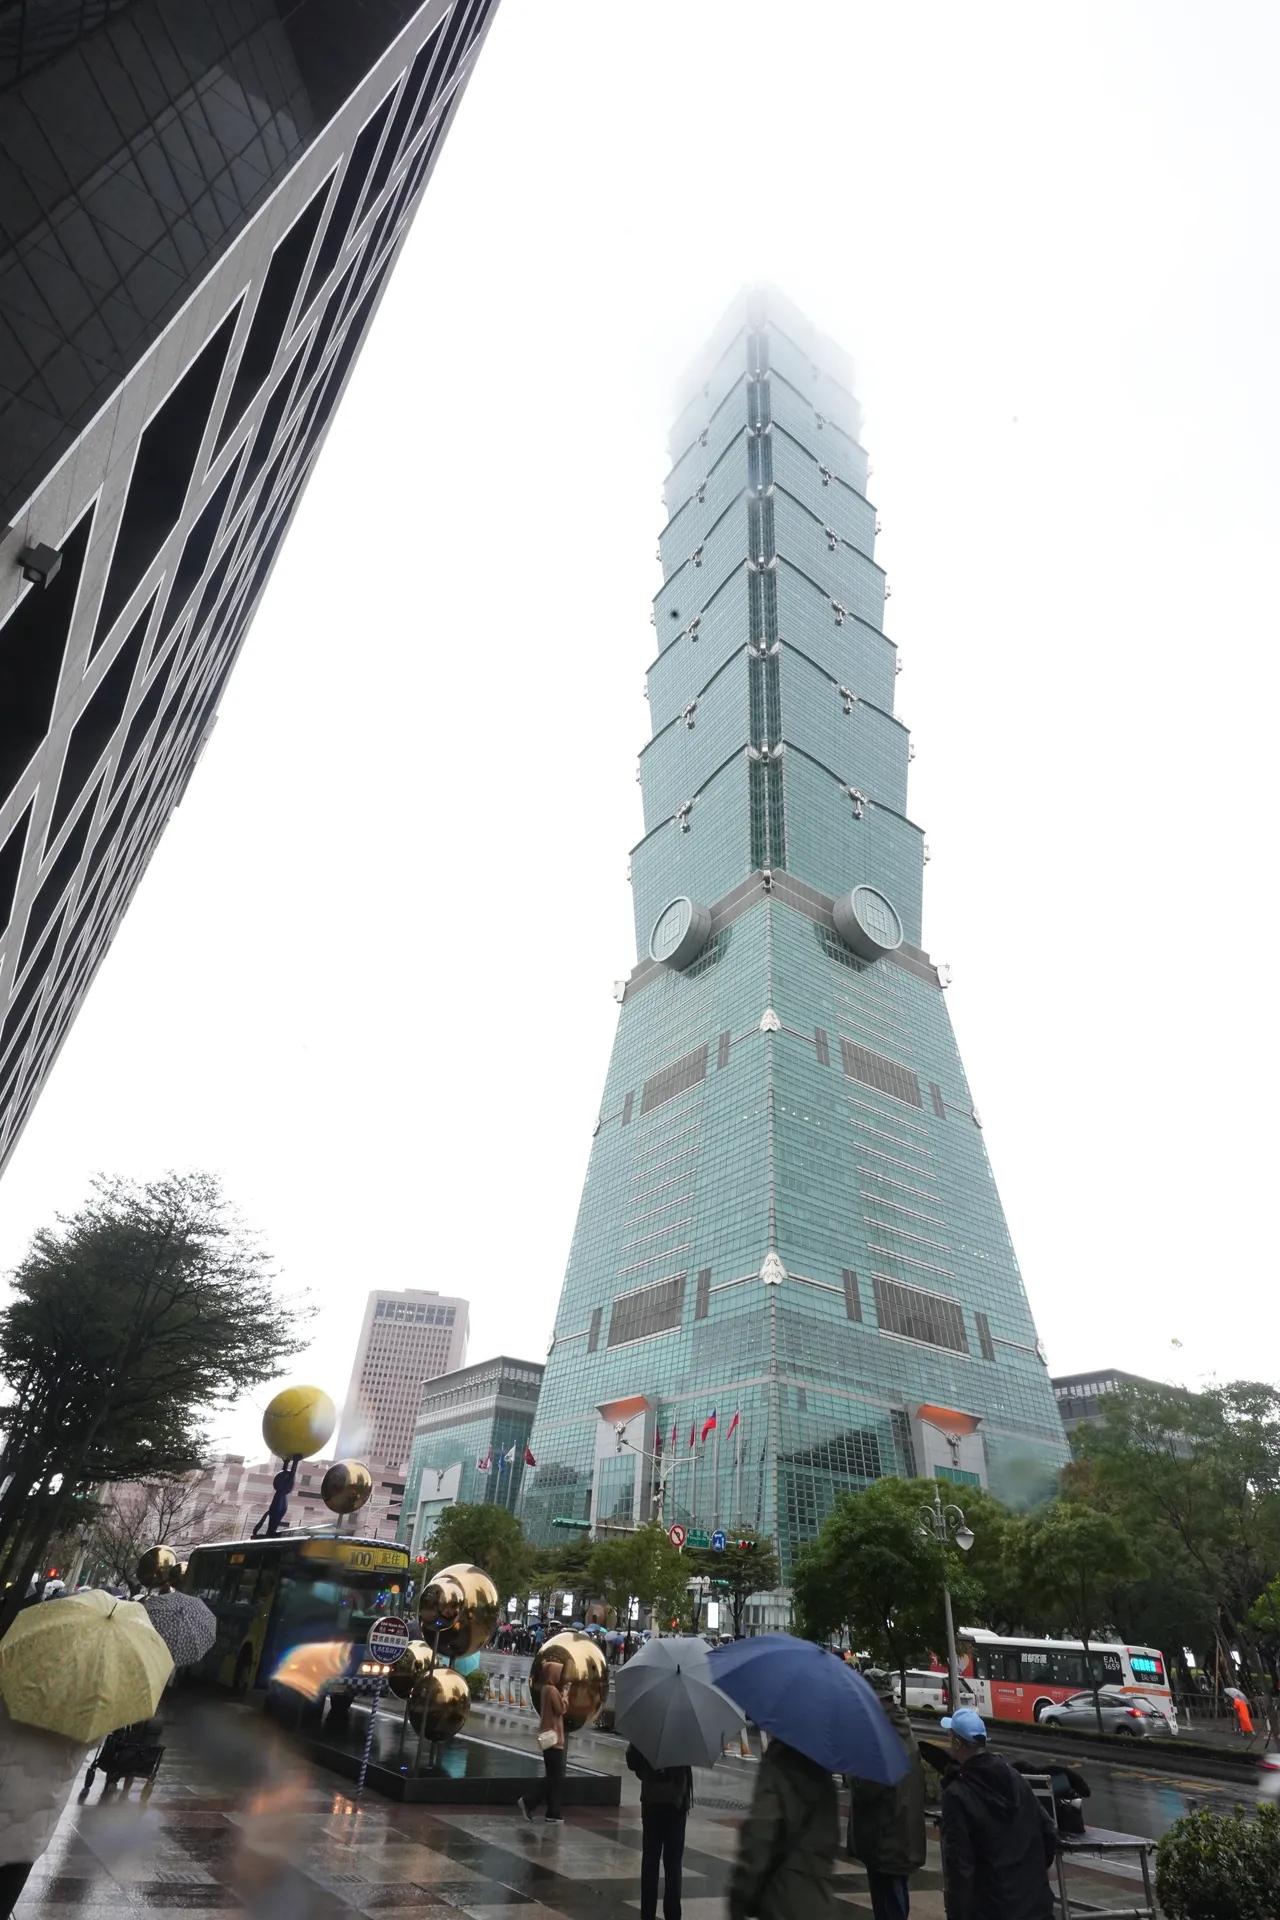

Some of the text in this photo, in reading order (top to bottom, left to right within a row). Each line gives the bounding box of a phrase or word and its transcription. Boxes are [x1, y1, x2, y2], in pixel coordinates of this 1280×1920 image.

[350, 1551, 372, 1567] 100
[381, 1552, 401, 1565] 記住
[1103, 1655, 1120, 1664] EAL
[1104, 1663, 1120, 1671] 1659
